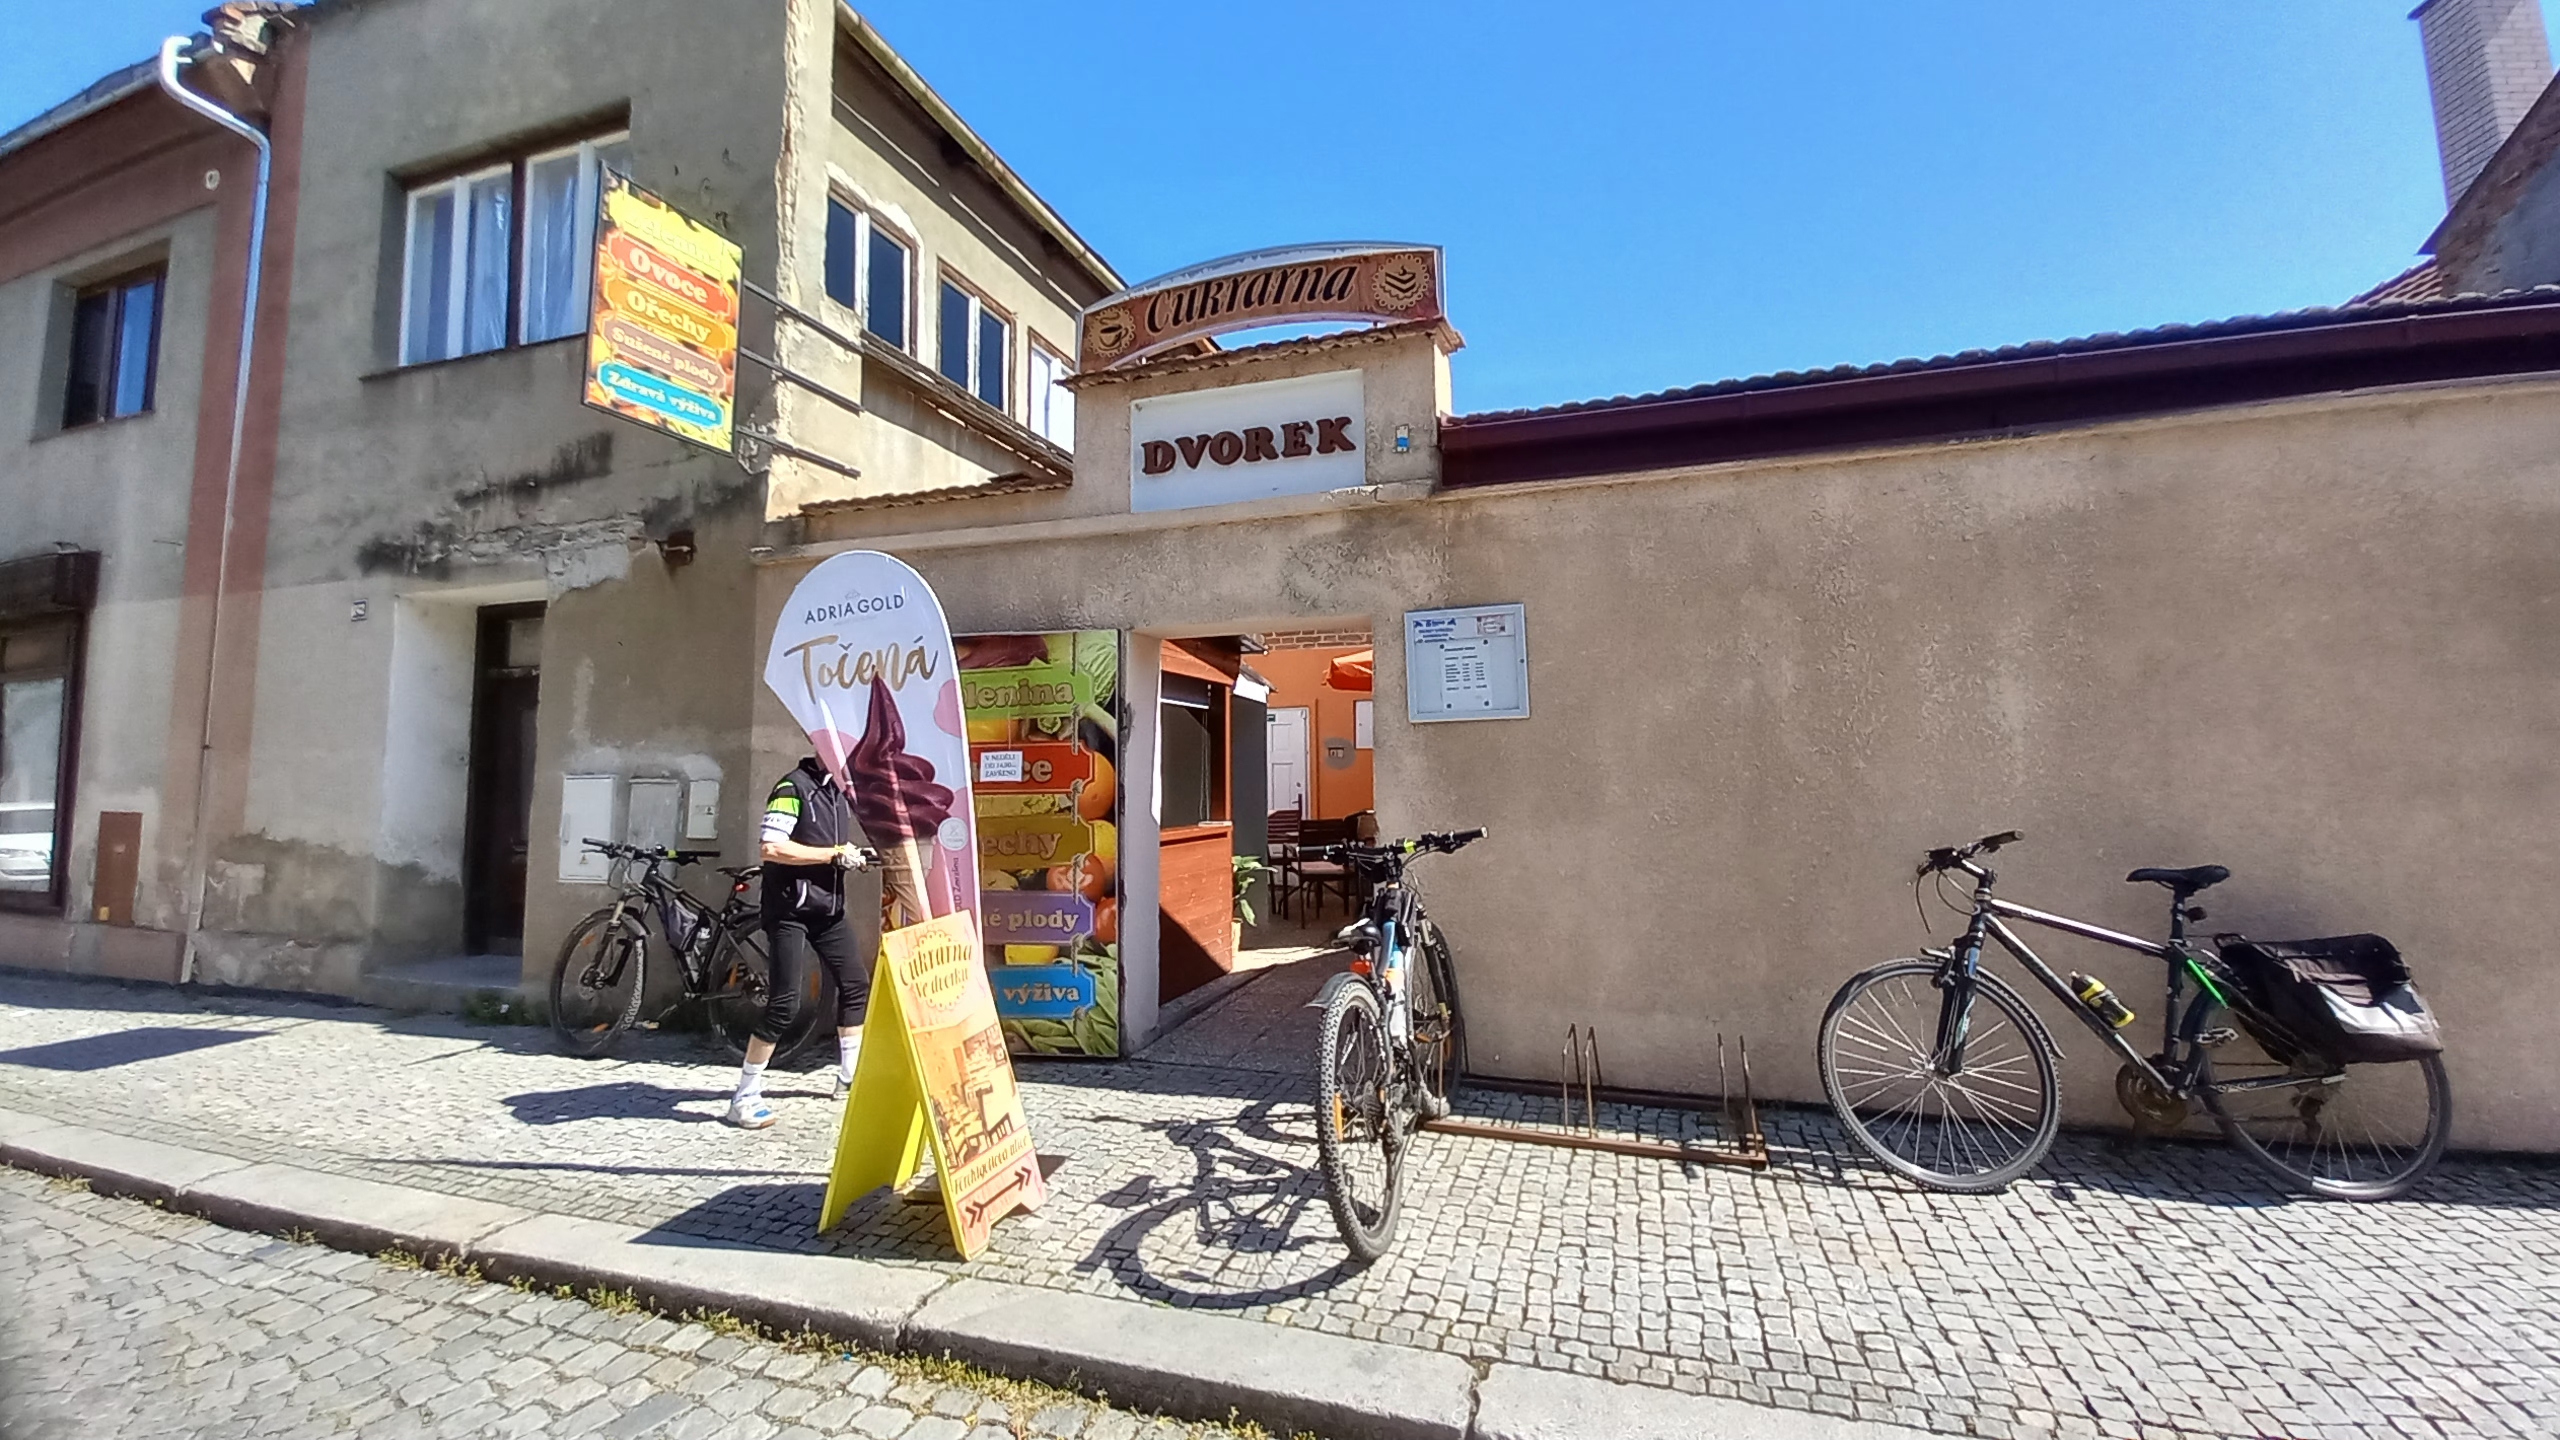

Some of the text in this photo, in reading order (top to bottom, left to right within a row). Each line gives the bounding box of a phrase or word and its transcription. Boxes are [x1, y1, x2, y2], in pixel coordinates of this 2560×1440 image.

[629, 247, 709, 304] Ovoce
[626, 289, 712, 343] Ořechy
[612, 327, 671, 364] Sušené
[607, 370, 666, 403] Zdravá
[1141, 416, 1357, 475] DVOREK
[804, 594, 905, 625] ADRIAGOLD
[783, 635, 939, 705] Točená
[961, 677, 1076, 710] lenina
[982, 829, 1062, 860] echy
[1007, 908, 1080, 933] plody
[1003, 983, 1080, 1006] výživa
